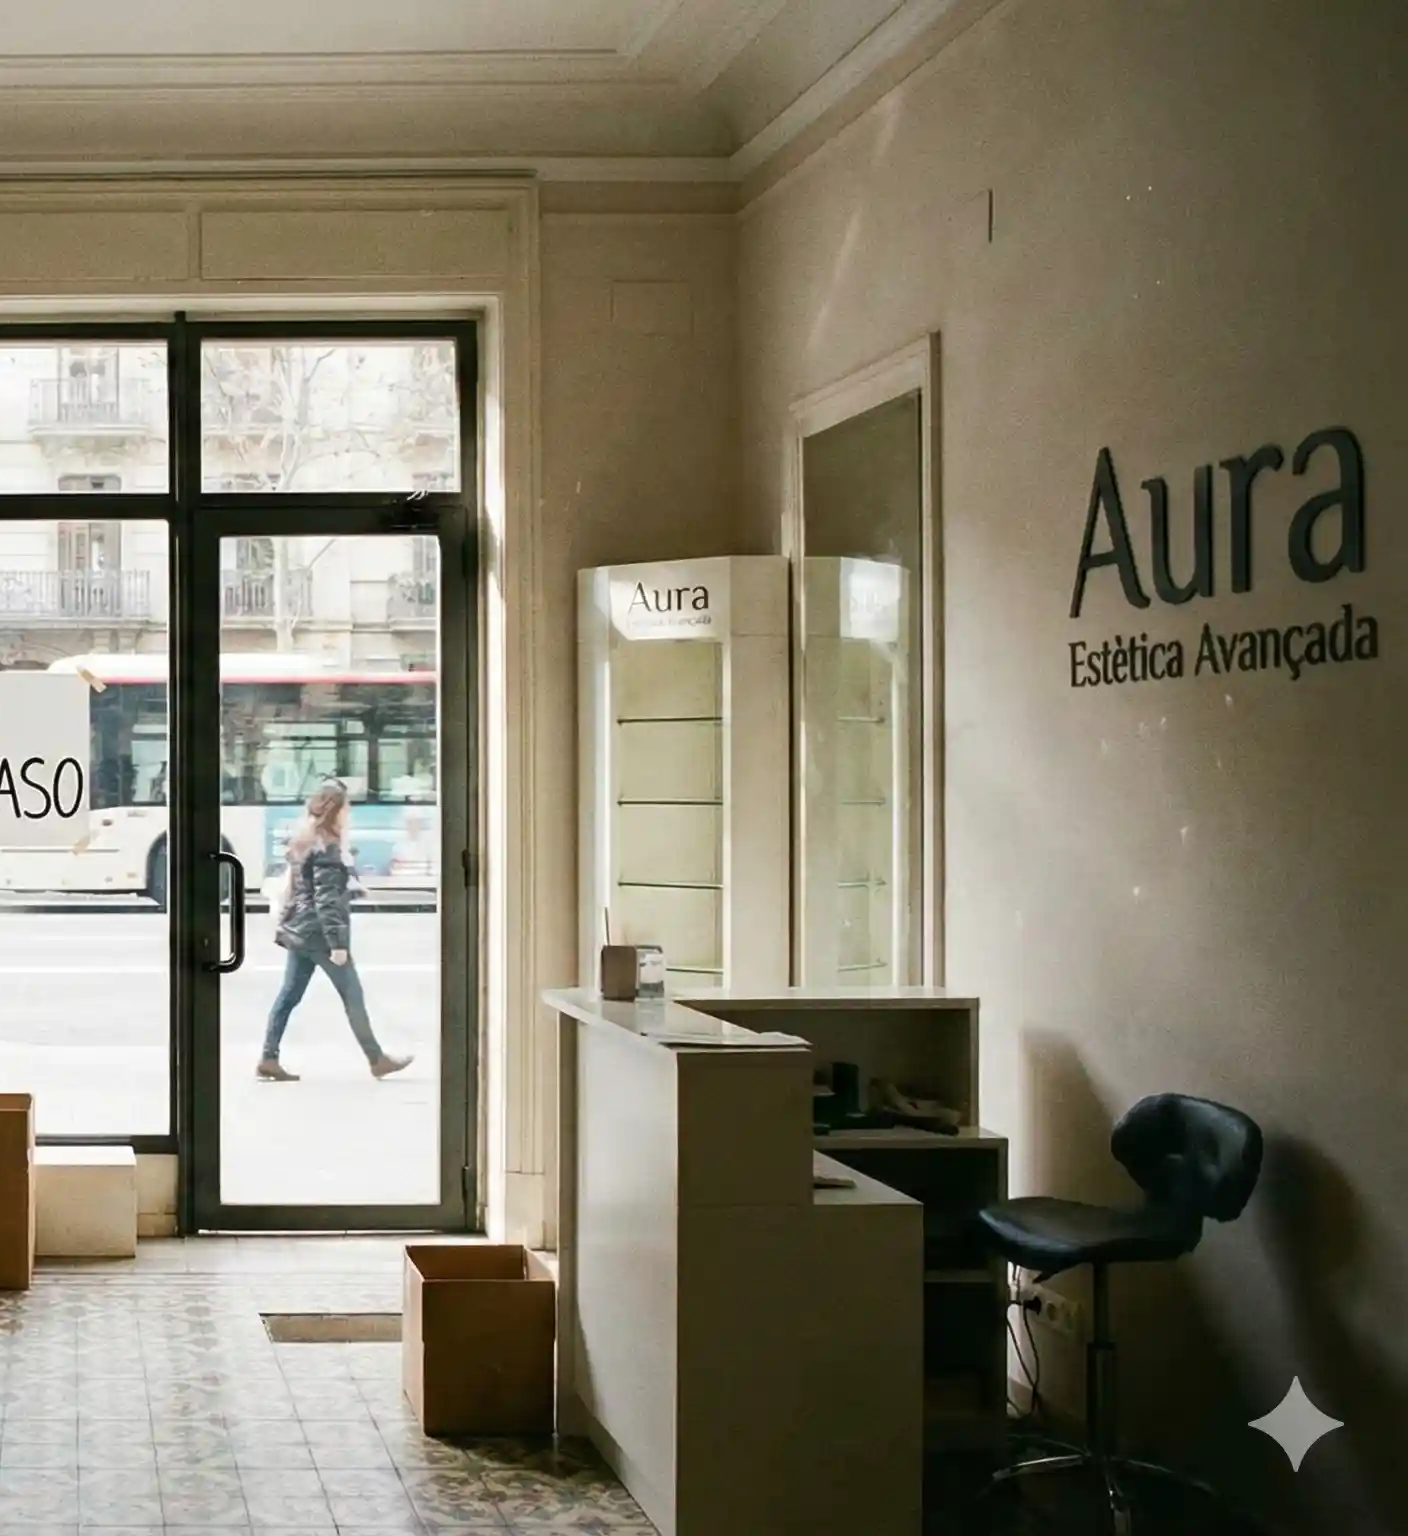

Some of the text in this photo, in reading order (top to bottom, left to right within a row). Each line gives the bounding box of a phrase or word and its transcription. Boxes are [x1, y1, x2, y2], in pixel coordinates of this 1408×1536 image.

[1069, 424, 1367, 619] Aura
[627, 581, 710, 614] Aura
[1068, 603, 1380, 688] Estètica Avançada
